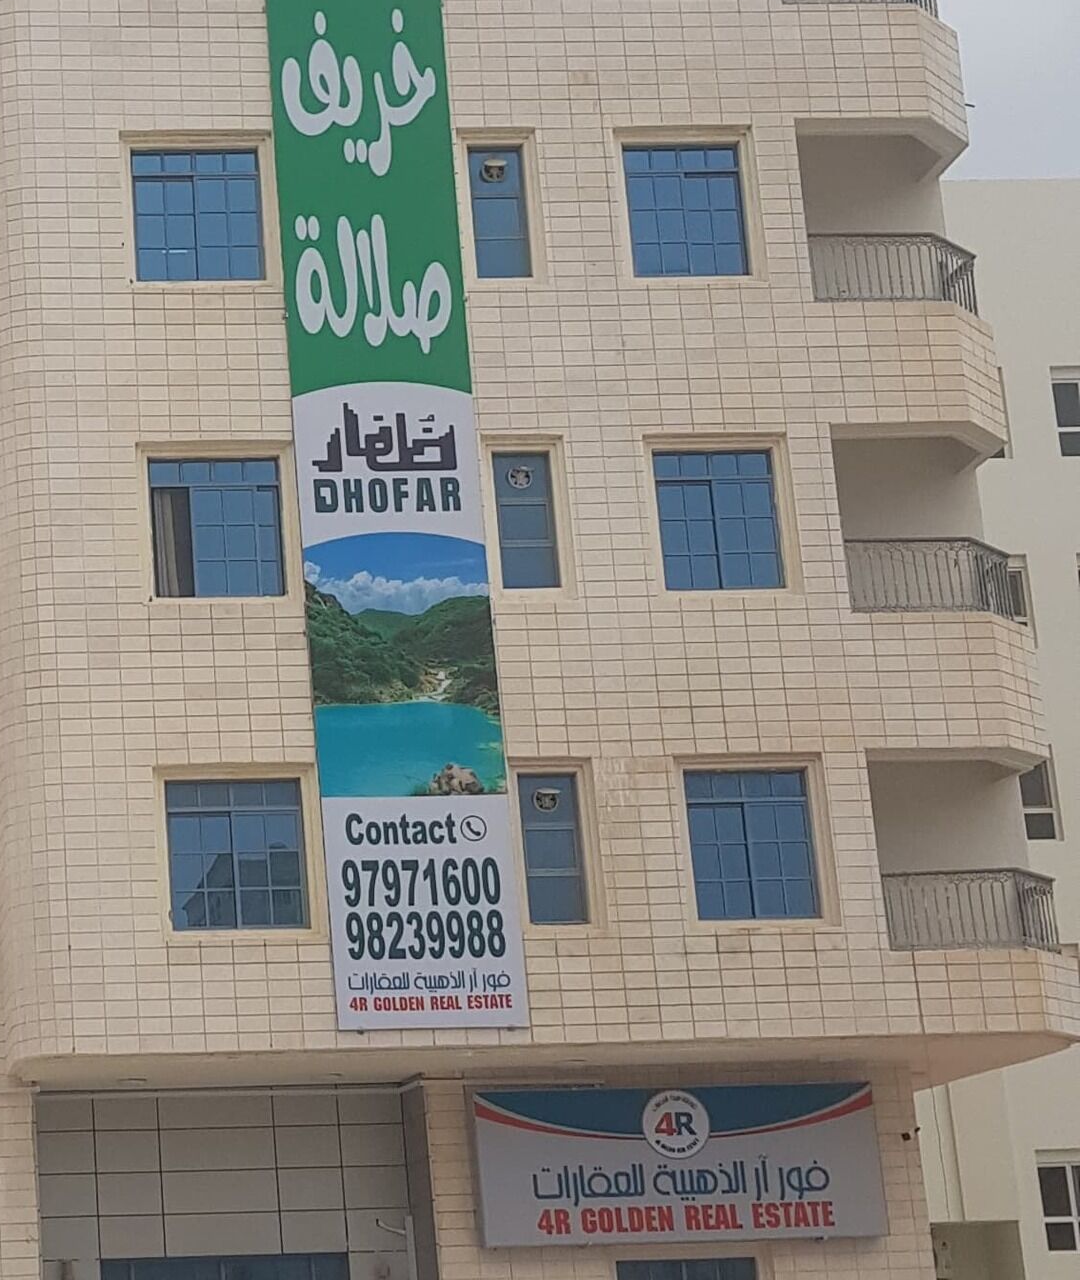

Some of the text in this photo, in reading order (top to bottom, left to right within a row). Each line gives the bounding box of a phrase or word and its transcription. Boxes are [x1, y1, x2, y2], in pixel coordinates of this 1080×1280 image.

[281, 8, 437, 177] خريف
[295, 213, 452, 354] صلالة
[313, 477, 462, 513] DHOFAR
[345, 812, 457, 846] Contact
[341, 857, 501, 907] 97971600
[345, 909, 506, 960] 98239988
[348, 972, 410, 995] للعقارات
[414, 970, 466, 993] الذهبية
[483, 970, 511, 992] فور
[349, 994, 513, 1011] 4R GOLDEN REAL ESTATE
[655, 1112, 697, 1136] 4R
[533, 1163, 645, 1207] للعقارات
[652, 1160, 747, 1201] الذهبية
[779, 1160, 830, 1200] فور
[537, 1201, 835, 1235] 4R GOLDEN REAL ESTATE
